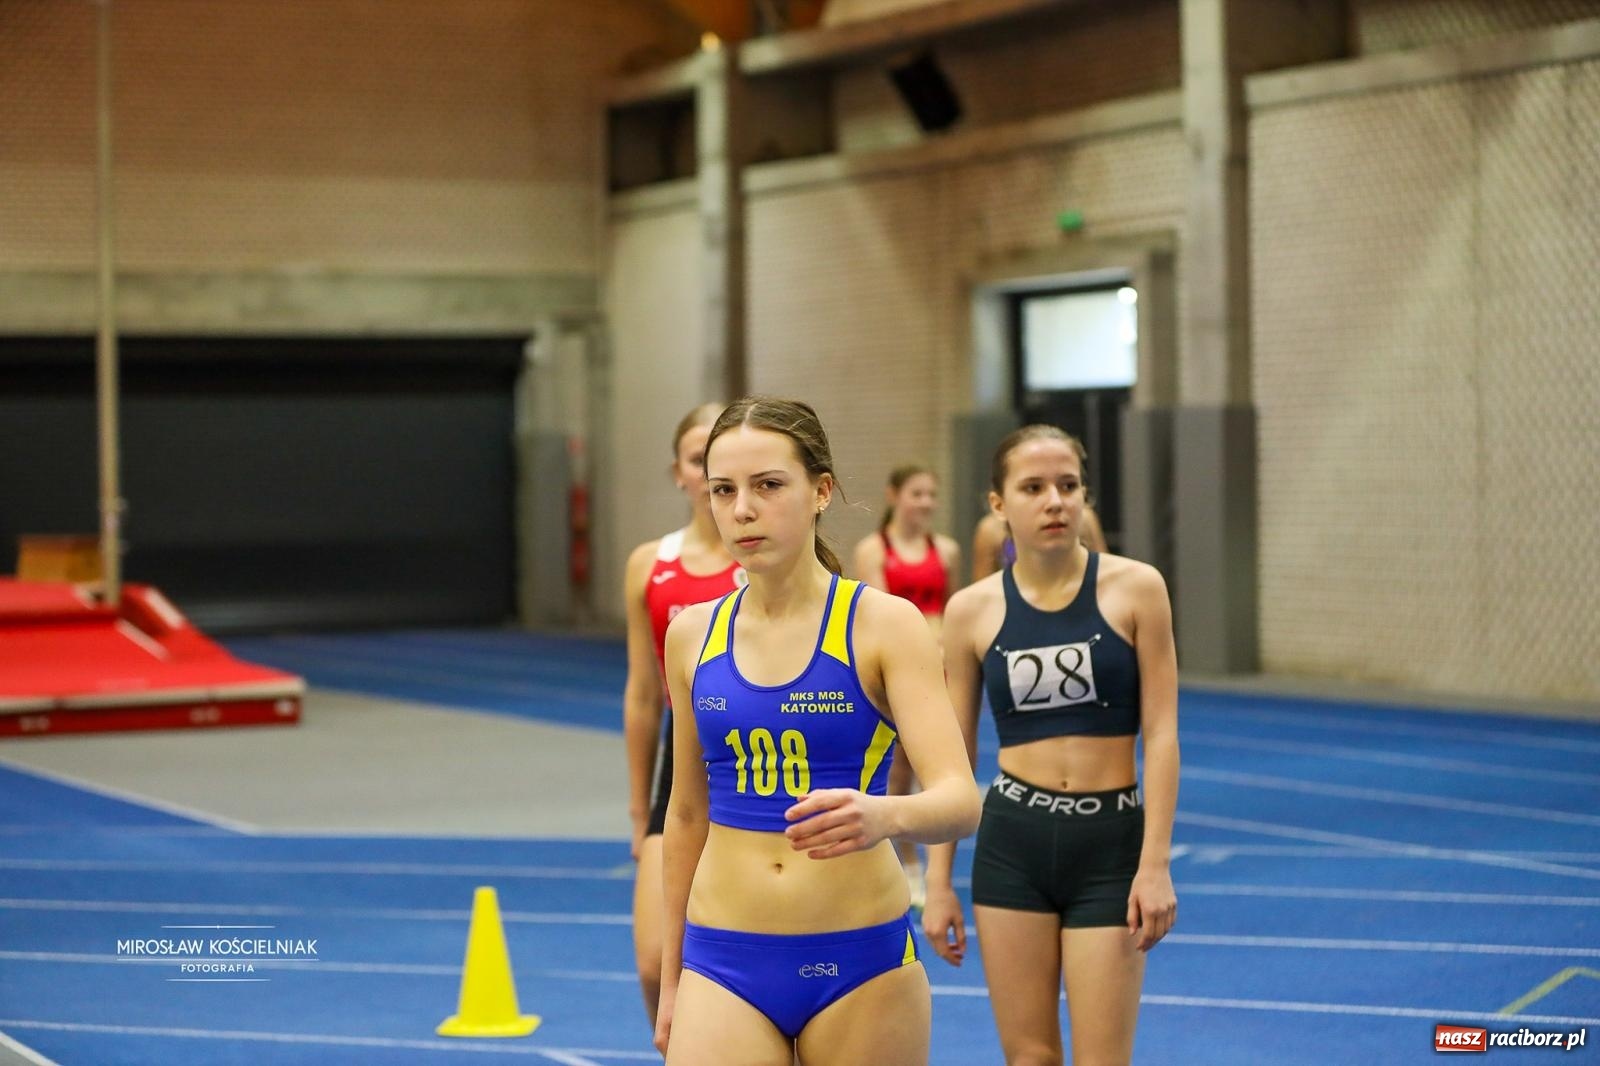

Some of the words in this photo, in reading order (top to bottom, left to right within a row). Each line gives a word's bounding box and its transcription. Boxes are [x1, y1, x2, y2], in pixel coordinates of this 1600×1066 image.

[1013, 647, 1091, 706] 28
[780, 703, 854, 713] KATOWICE
[789, 692, 814, 701] MKS
[818, 691, 844, 700] MOS
[724, 727, 811, 797] 108
[1028, 788, 1102, 815] PRO
